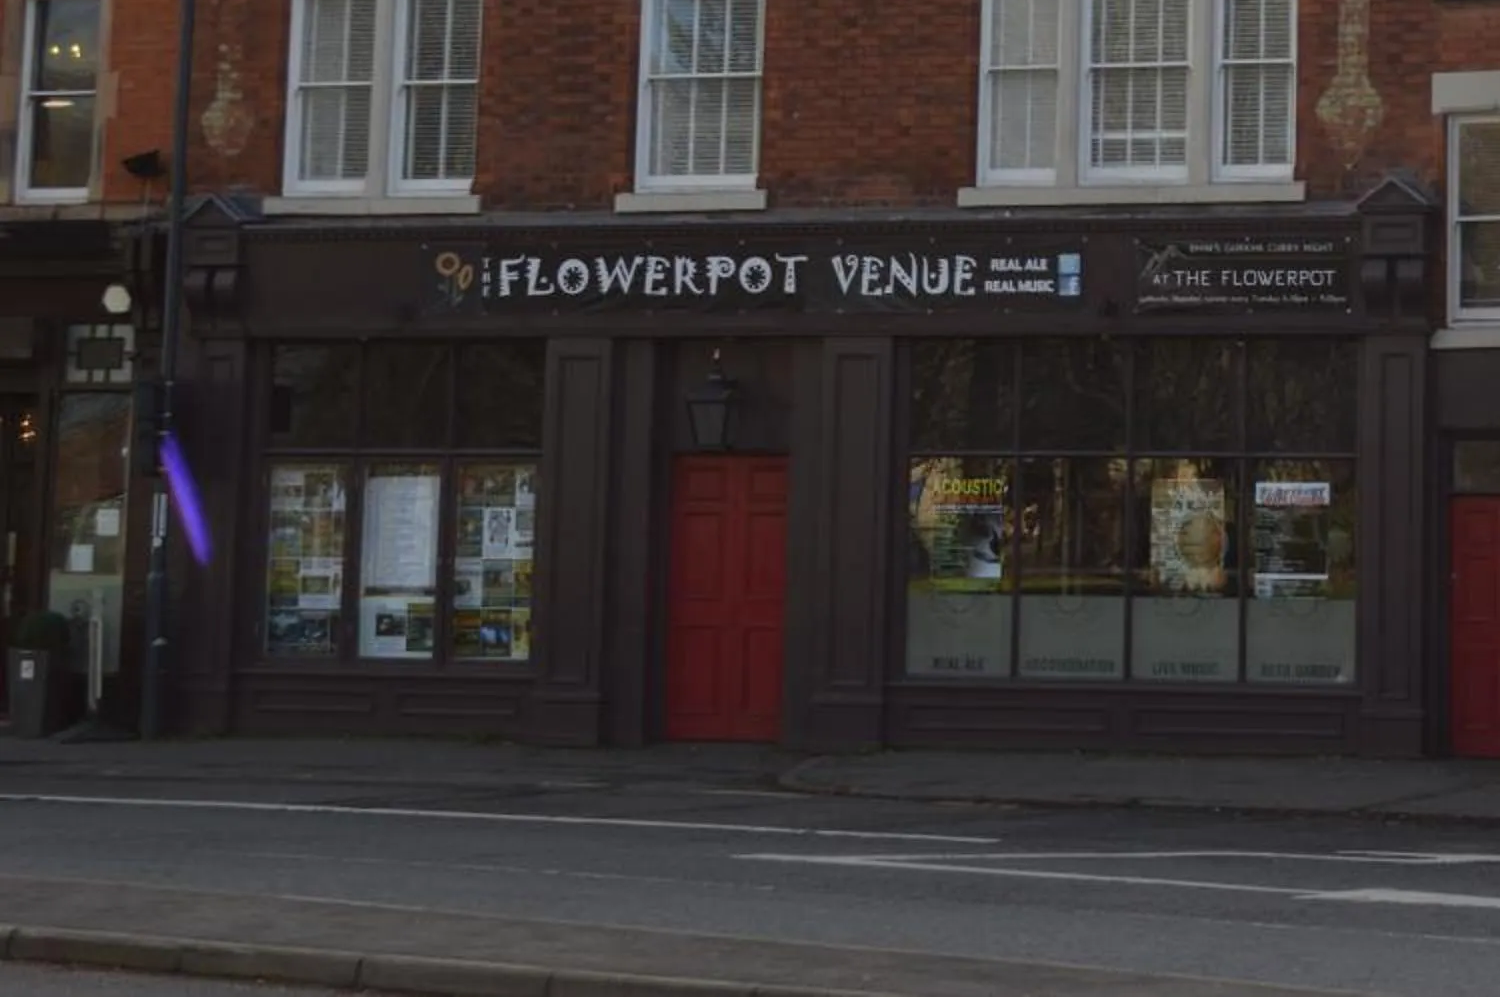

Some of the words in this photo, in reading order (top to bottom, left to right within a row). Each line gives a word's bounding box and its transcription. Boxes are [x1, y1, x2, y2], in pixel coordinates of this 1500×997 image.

[991, 258, 1022, 271] REAL
[1024, 258, 1048, 271] ALE
[499, 254, 808, 296] FLOWERPOT
[832, 253, 977, 296] VENUE
[1173, 270, 1211, 286] THE
[1221, 270, 1336, 286] FLOWERPOT
[985, 280, 1016, 293] REAL
[1017, 280, 1054, 293] MUSIC
